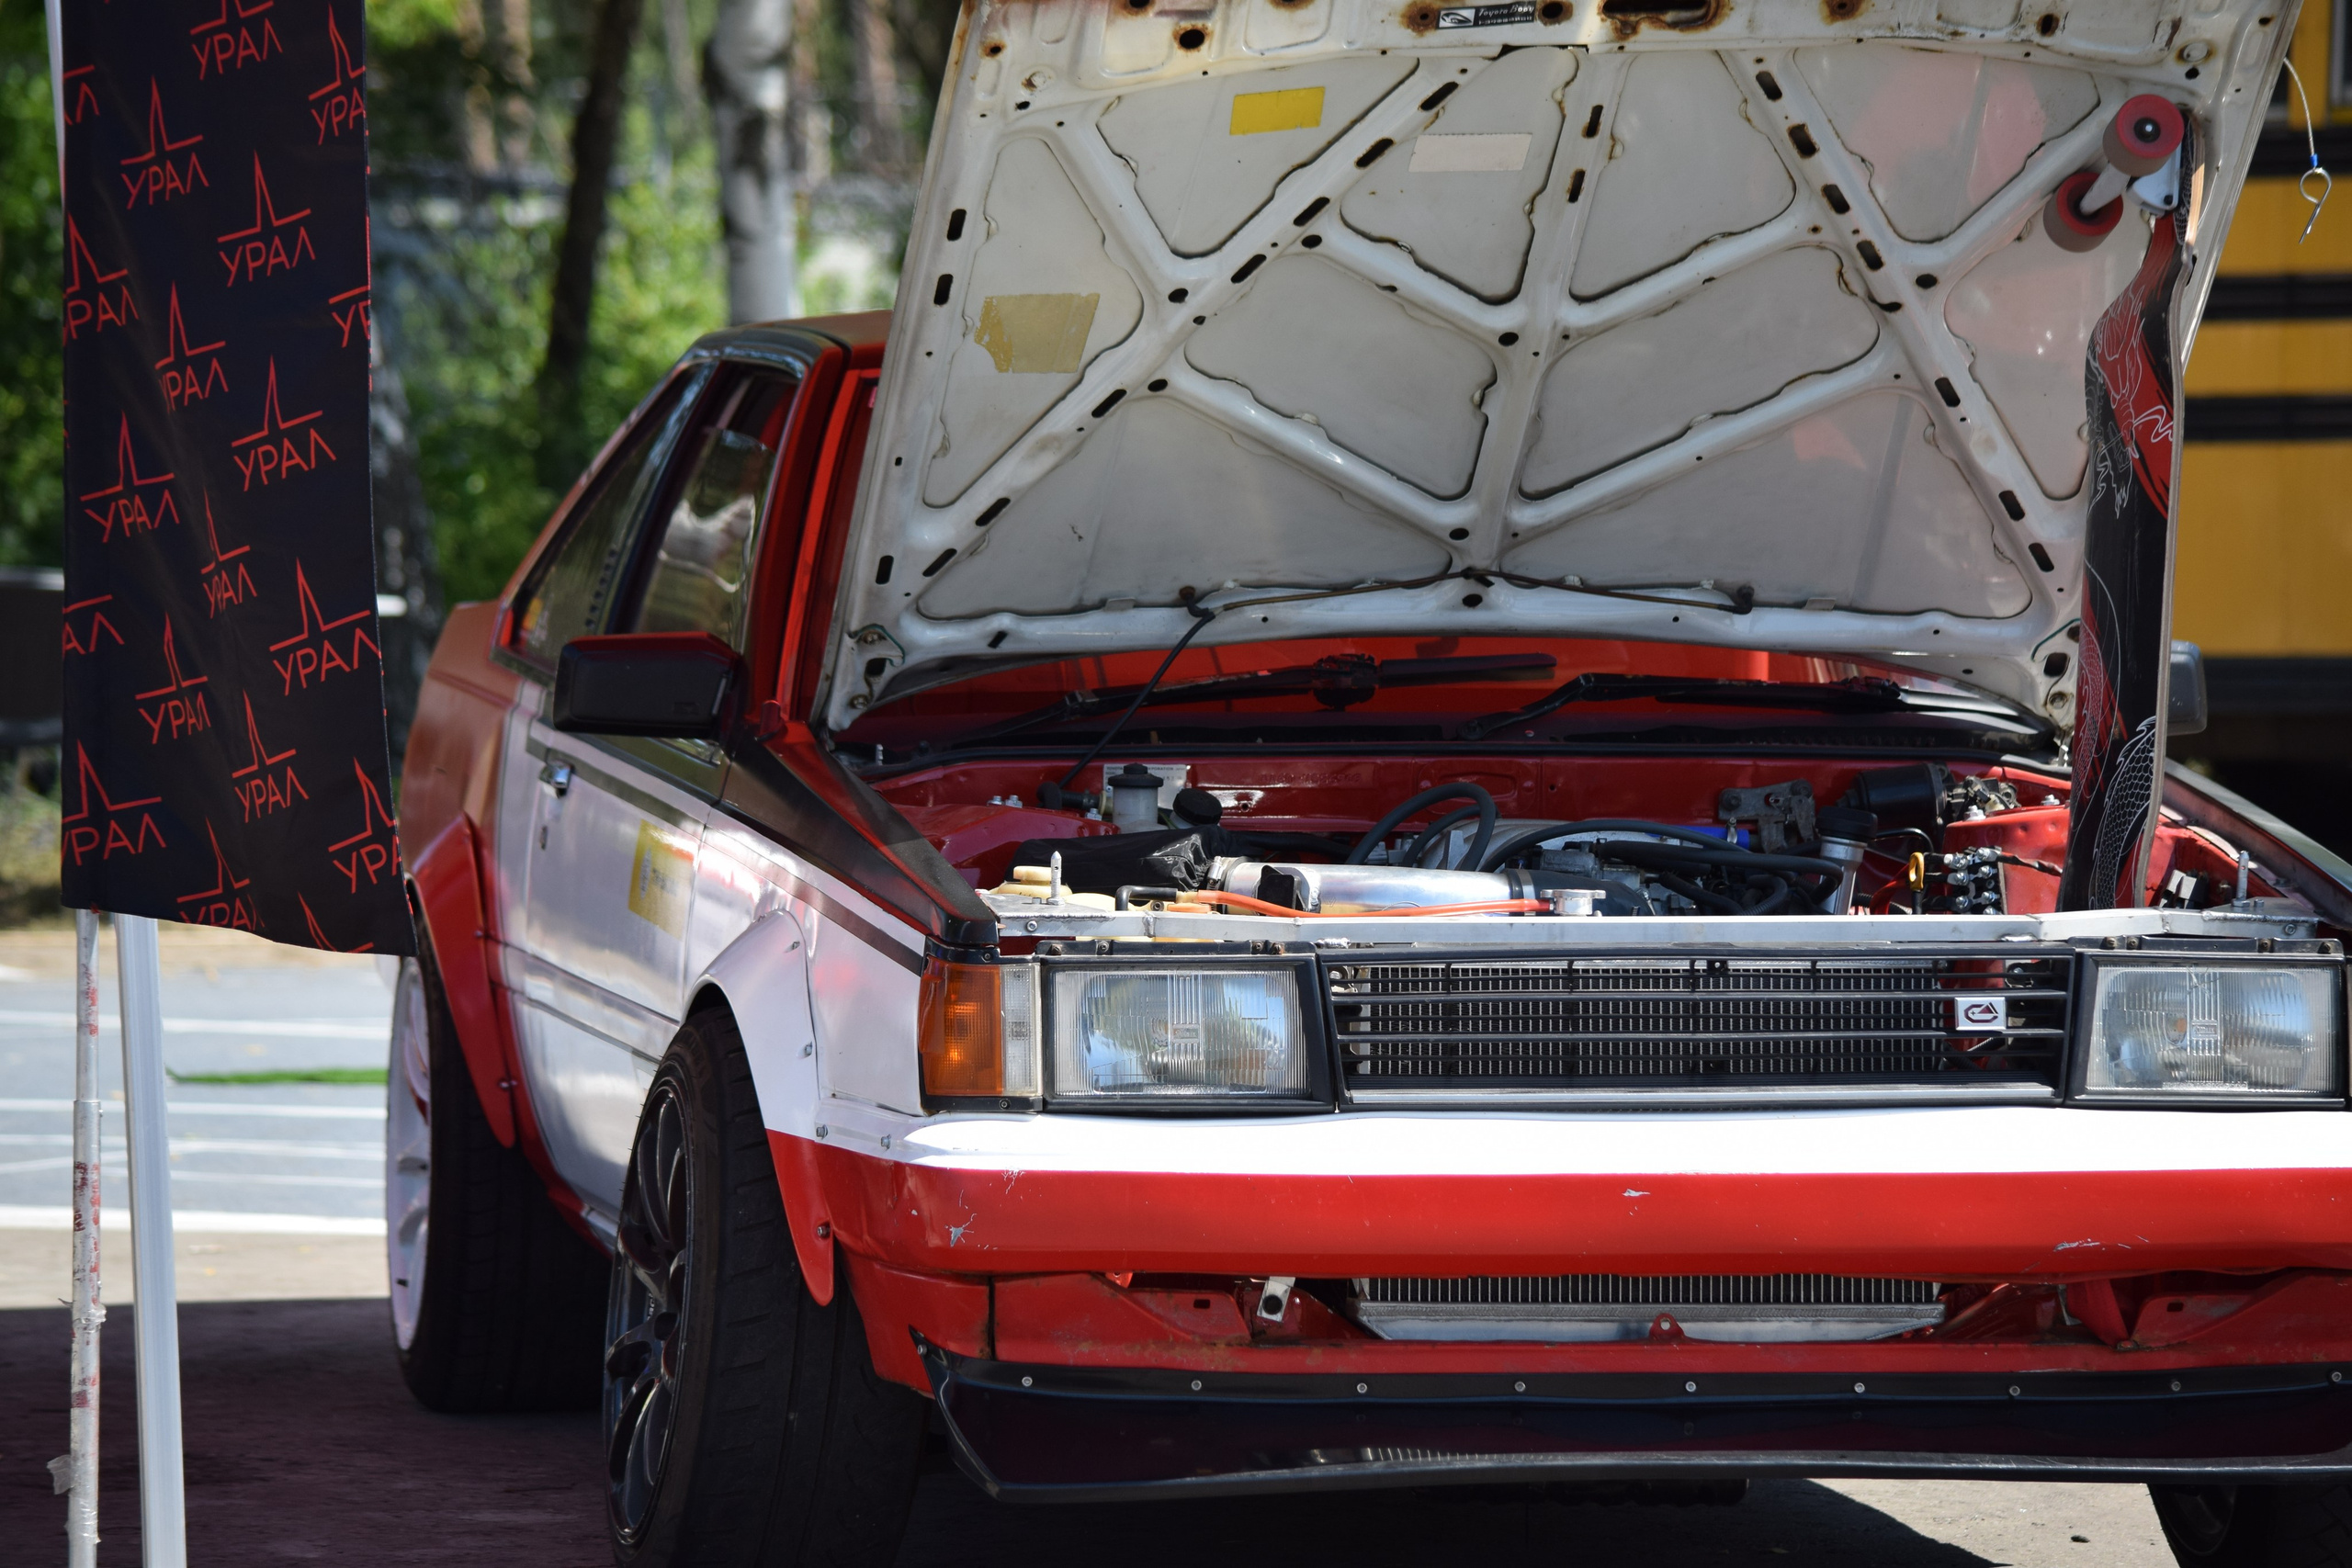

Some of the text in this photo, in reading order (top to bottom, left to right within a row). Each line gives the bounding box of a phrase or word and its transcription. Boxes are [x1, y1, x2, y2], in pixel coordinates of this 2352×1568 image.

[192, 18, 282, 80] УРАЛ
[311, 86, 367, 145] УРА
[121, 152, 209, 209] УРАЛ
[220, 226, 315, 287] УРАЛ
[63, 284, 139, 347] РАЛ
[332, 299, 371, 348] УР
[233, 428, 336, 491] УРАЛ
[85, 490, 179, 543] УРАЛ
[203, 562, 257, 618] УРАЛ
[62, 612, 124, 660] АЛ
[273, 627, 382, 696] УРАЛ
[139, 692, 210, 744] УРАЛ
[234, 766, 309, 823] УРАЛ
[333, 834, 402, 895] УР
